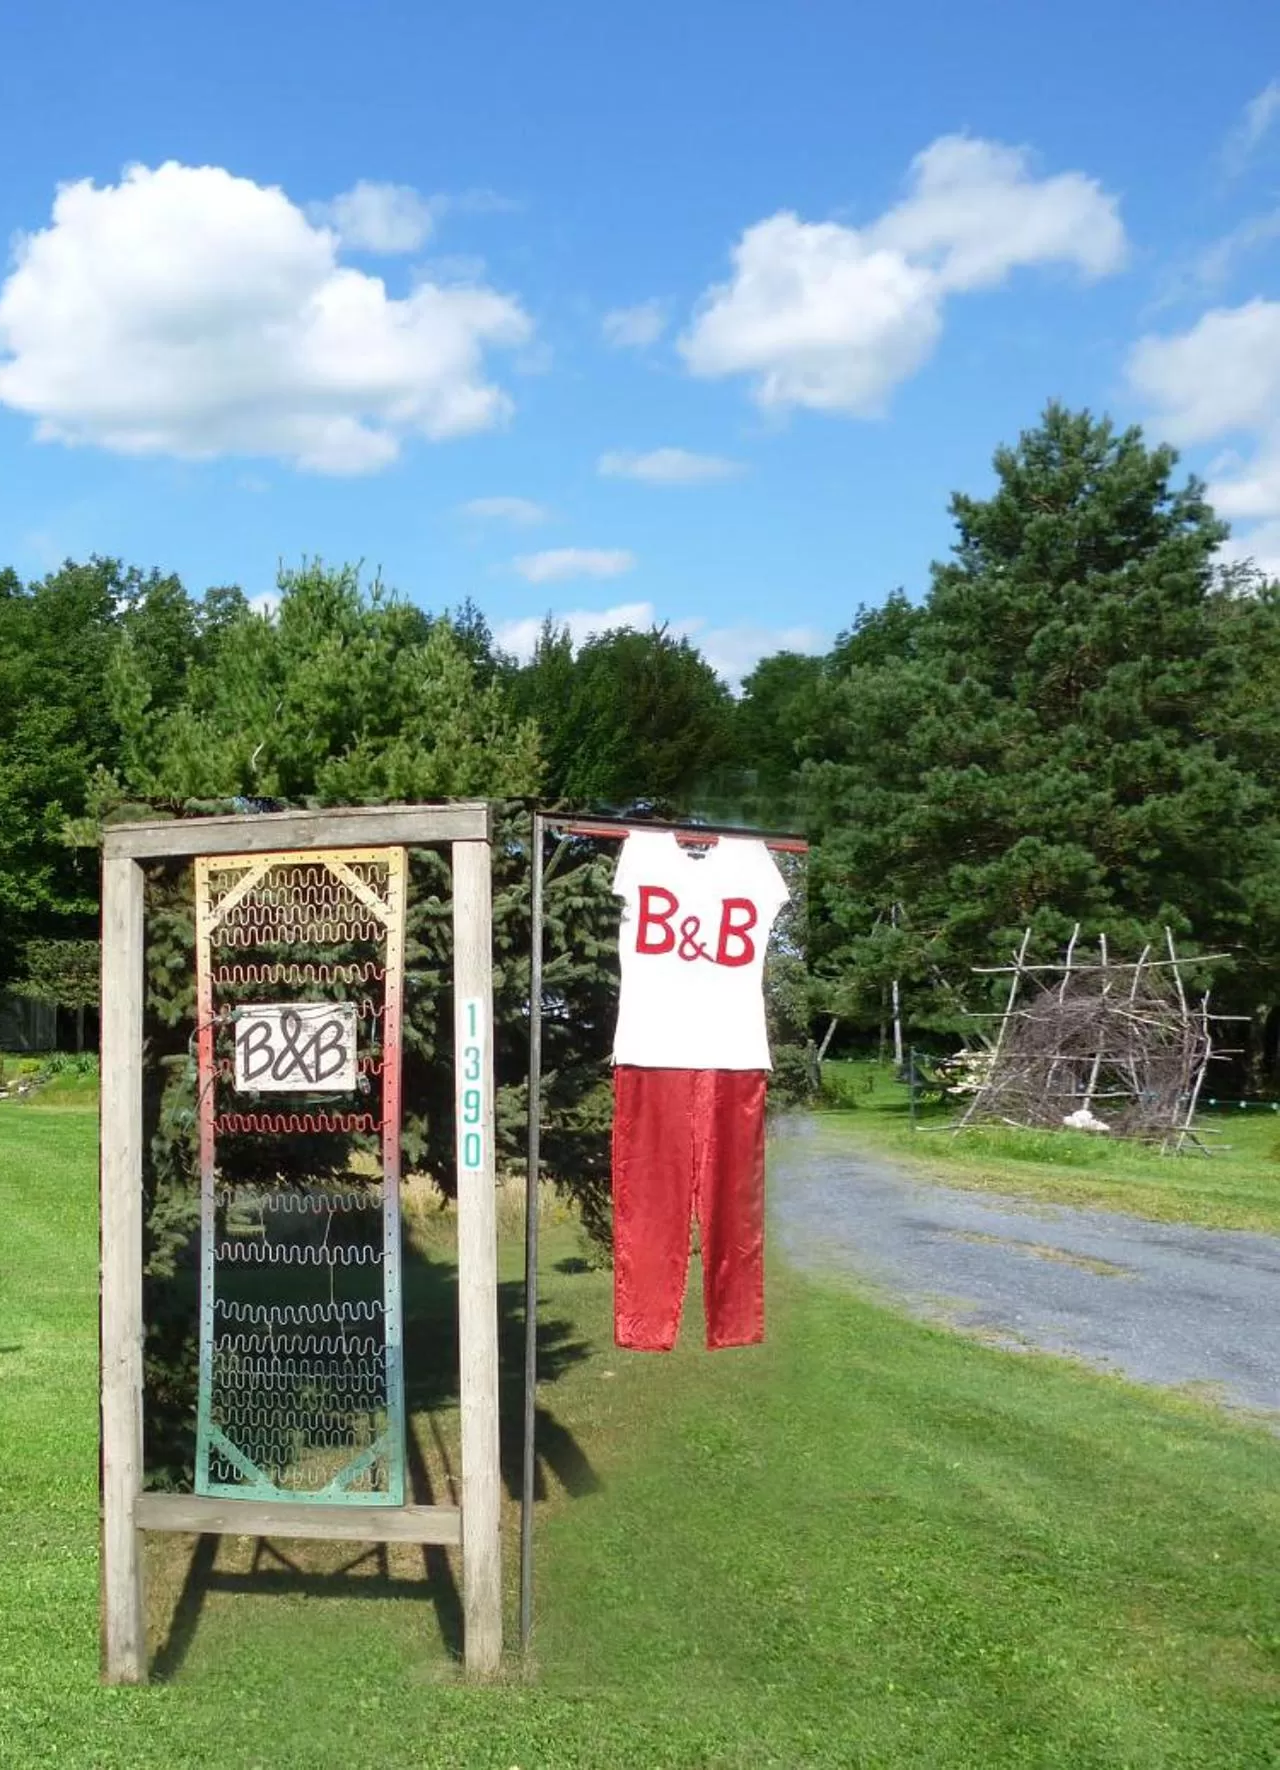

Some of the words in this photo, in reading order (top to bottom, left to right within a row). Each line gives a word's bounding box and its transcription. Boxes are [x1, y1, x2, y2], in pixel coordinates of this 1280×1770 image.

[635, 885, 758, 967] B&B
[236, 1008, 347, 1083] B&B
[463, 1003, 481, 1168] 1390
